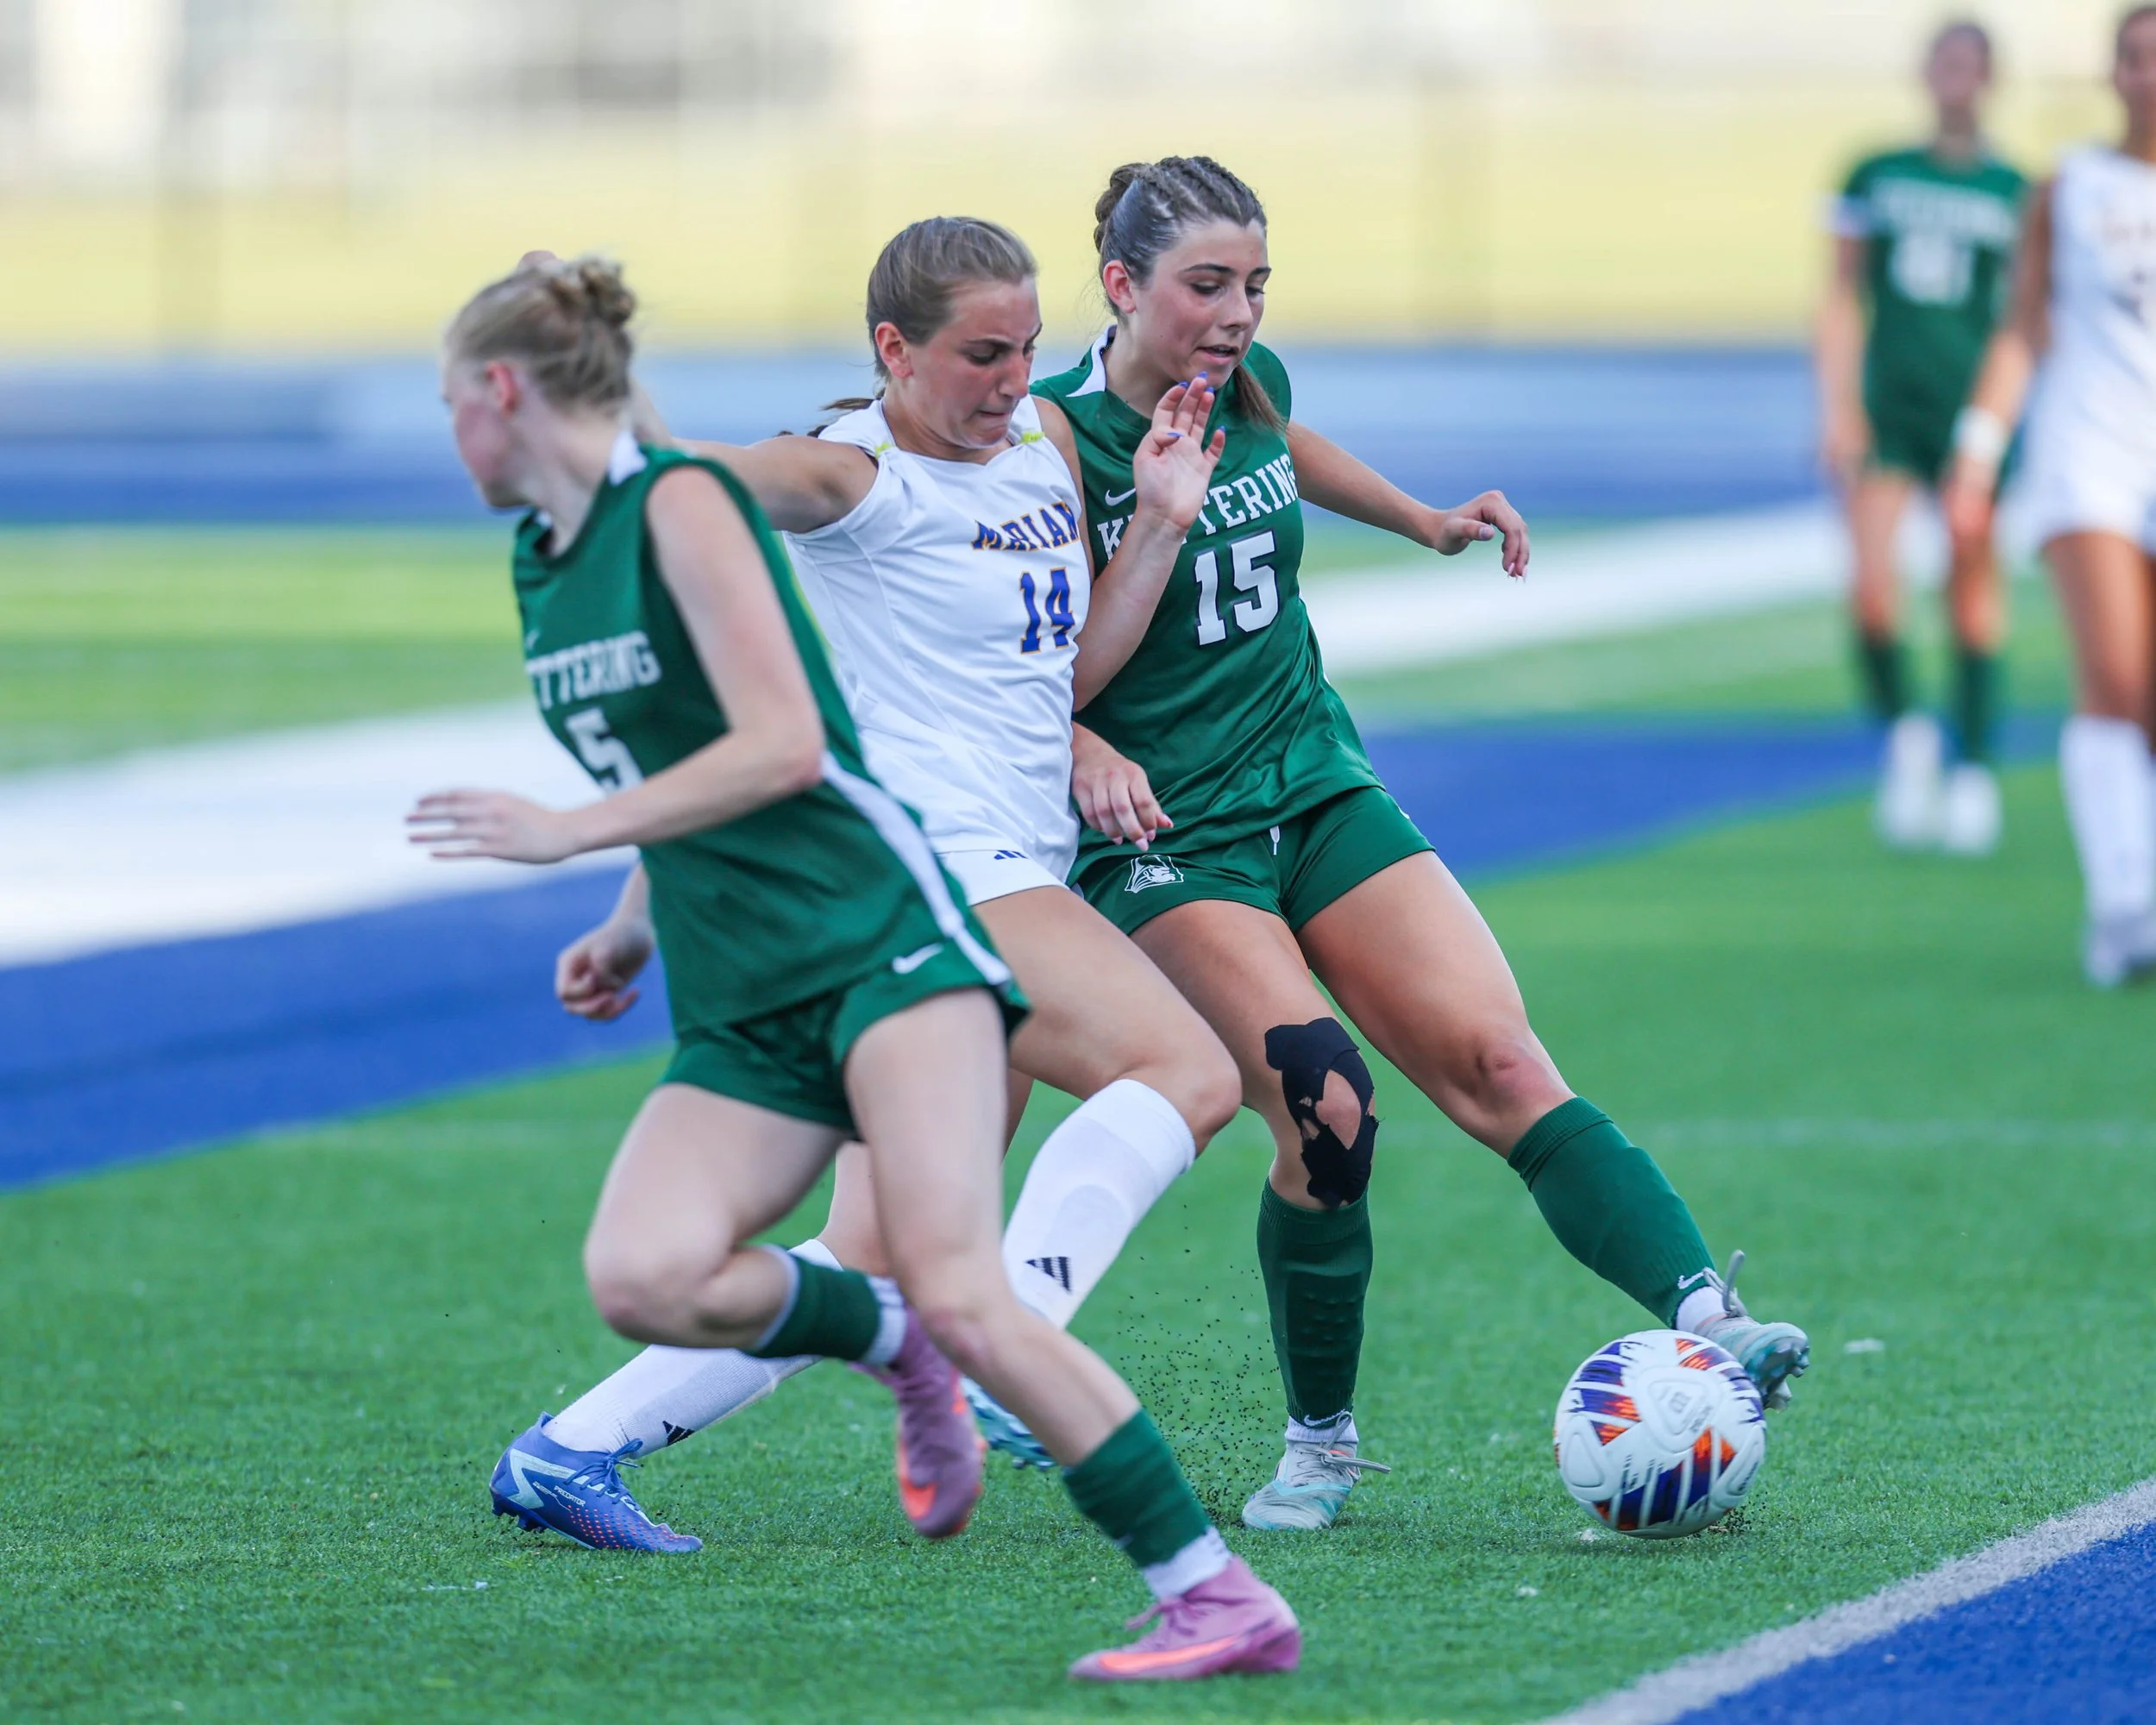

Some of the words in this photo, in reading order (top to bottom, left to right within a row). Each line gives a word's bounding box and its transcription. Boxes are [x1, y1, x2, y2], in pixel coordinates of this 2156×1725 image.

[1096, 453, 1299, 563] KTERING
[1019, 566, 1075, 655] 14
[1194, 529, 1279, 646] 15
[565, 706, 645, 794] 5
